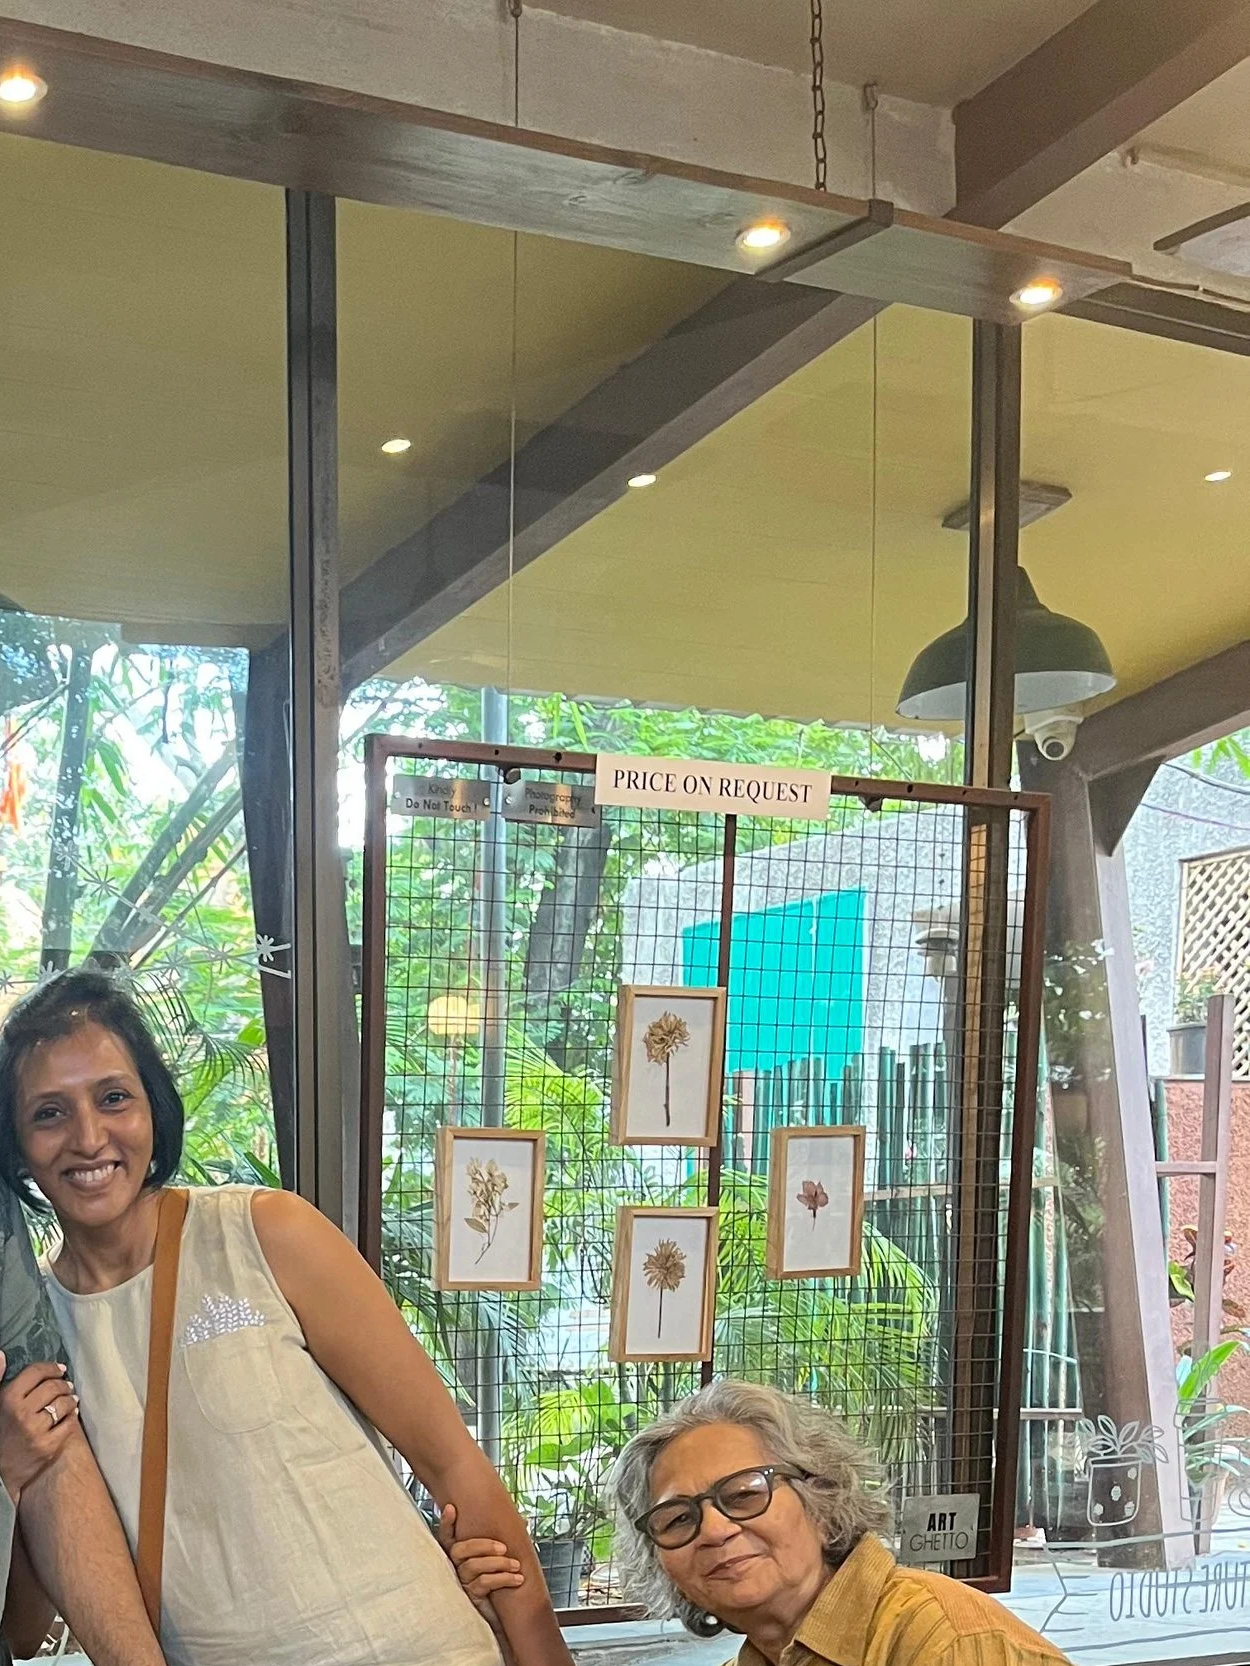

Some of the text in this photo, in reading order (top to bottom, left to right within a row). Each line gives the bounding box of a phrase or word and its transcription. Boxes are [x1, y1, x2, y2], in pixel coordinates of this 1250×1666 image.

[427, 782, 457, 798] Kindly
[613, 768, 813, 804] PRICE ON REQUEST
[405, 797, 419, 809] Do
[423, 798, 442, 810] Not
[444, 800, 472, 813] Touch
[524, 787, 582, 809] Photography
[528, 803, 576, 819] Prohibited
[927, 1511, 957, 1532] ART
[910, 1531, 969, 1552] GHETTO
